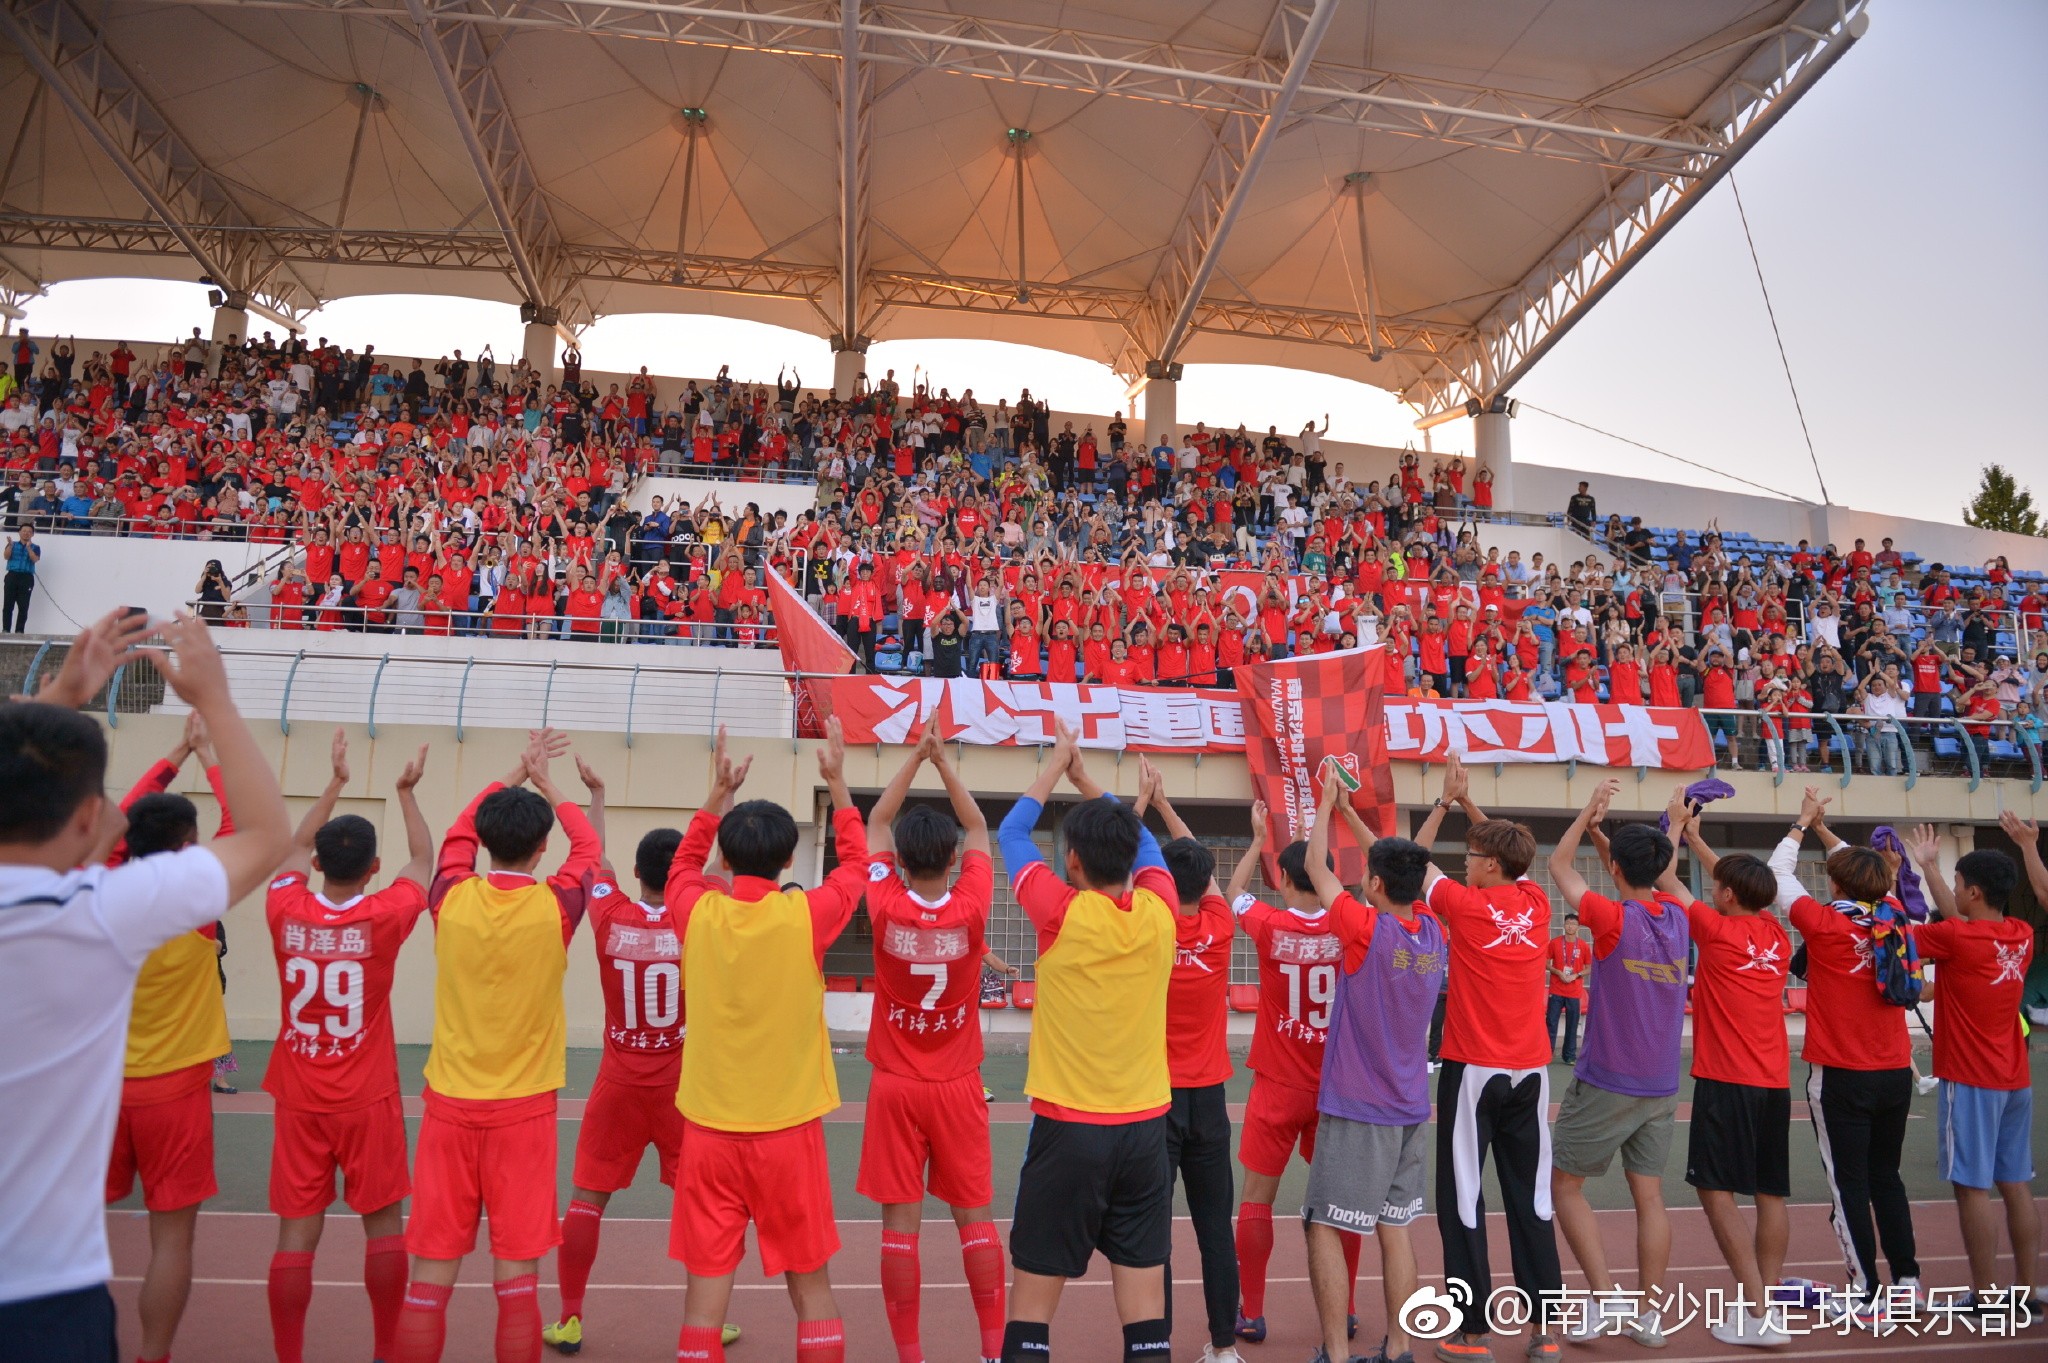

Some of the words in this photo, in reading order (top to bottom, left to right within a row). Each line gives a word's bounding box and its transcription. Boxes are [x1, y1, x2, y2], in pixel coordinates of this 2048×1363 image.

[1270, 677, 1286, 734] NANJING
[1275, 736, 1292, 773] SHAYE
[1384, 697, 1680, 769] 功立叶
[1282, 776, 1299, 837] FOOTBALL
[285, 924, 366, 955] 肖泽岛
[1274, 936, 1340, 960] 卢茂春
[285, 956, 365, 1039] 29
[613, 958, 680, 1029] 10
[910, 963, 947, 1011] 7
[1279, 963, 1336, 1029] 19
[678, 1350, 709, 1359] NAIS
[800, 1334, 842, 1345] SUNAIS
